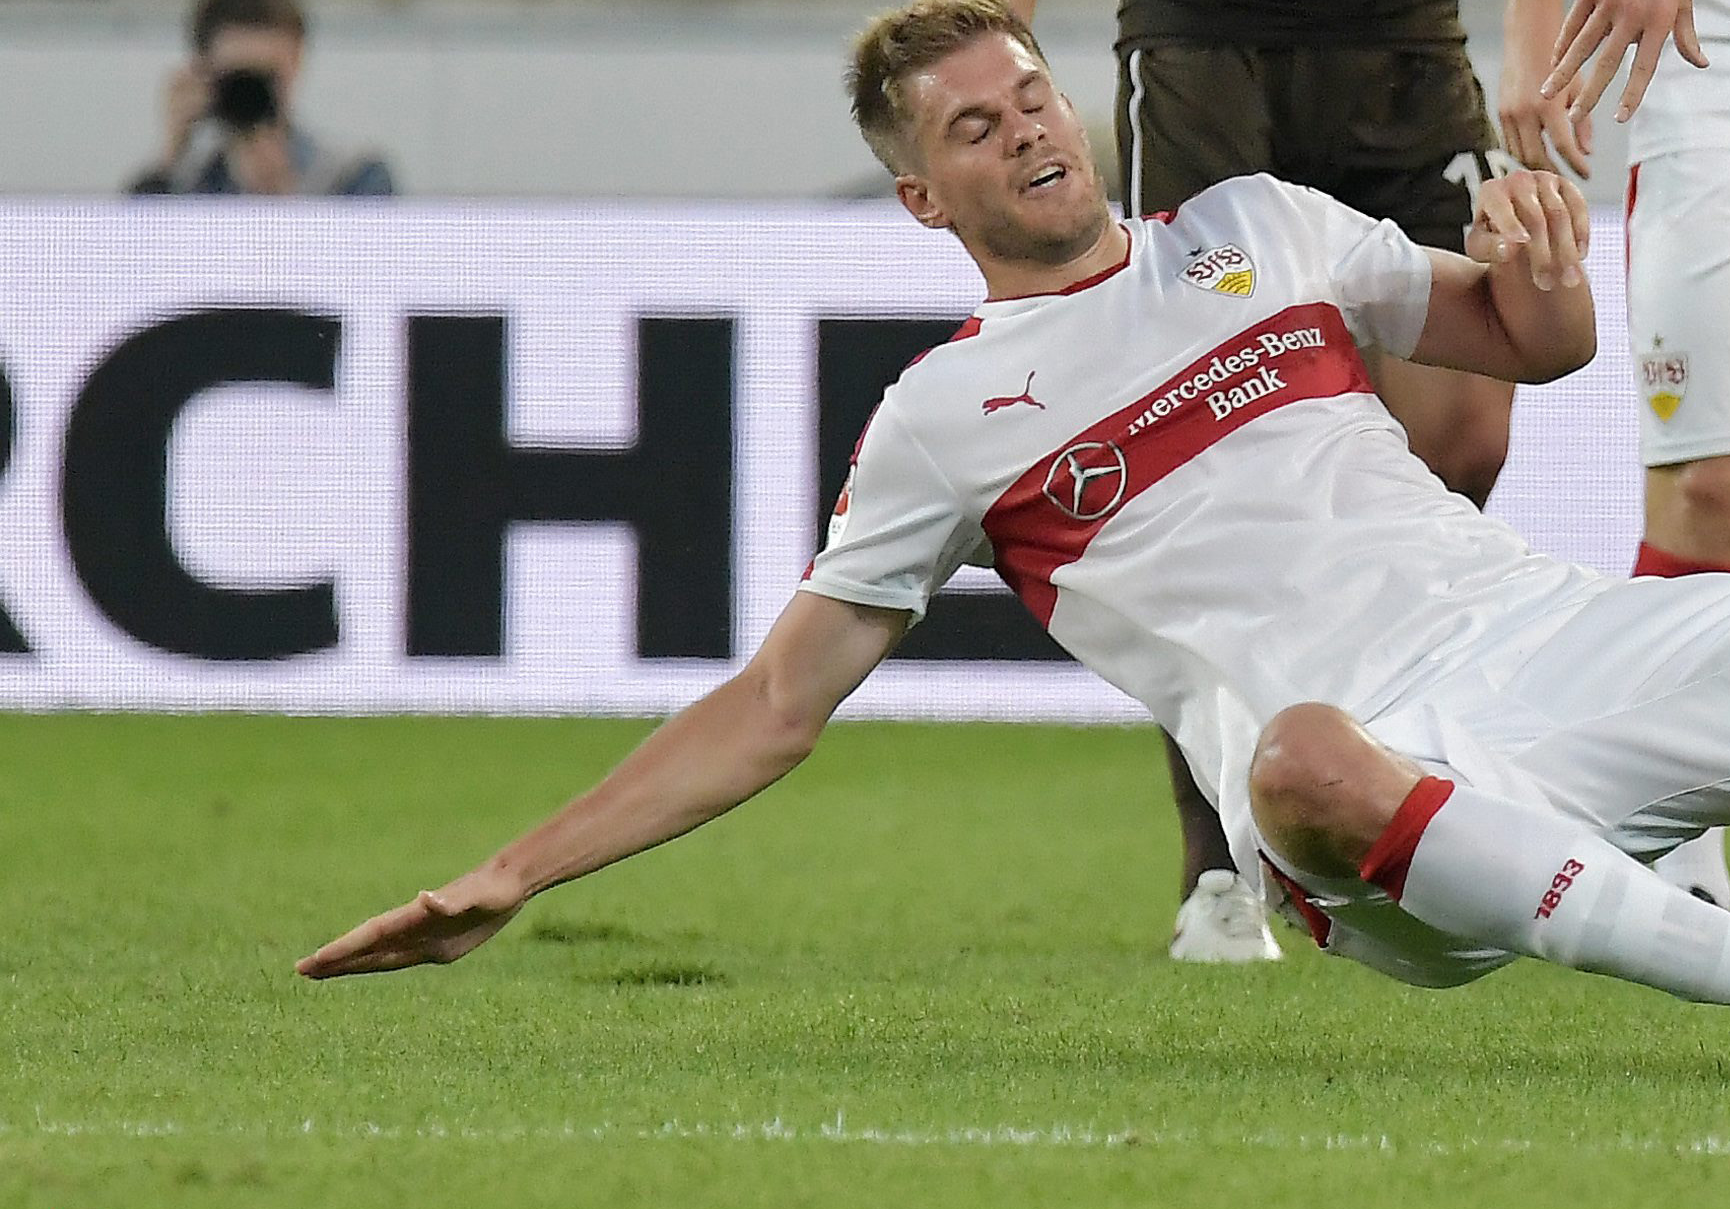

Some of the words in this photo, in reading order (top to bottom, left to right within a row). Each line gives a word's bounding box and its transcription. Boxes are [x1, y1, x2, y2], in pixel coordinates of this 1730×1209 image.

[1127, 327, 1326, 437] Mercedes-Benz
[1204, 367, 1288, 422] Bank
[1534, 858, 1585, 920] 1893
